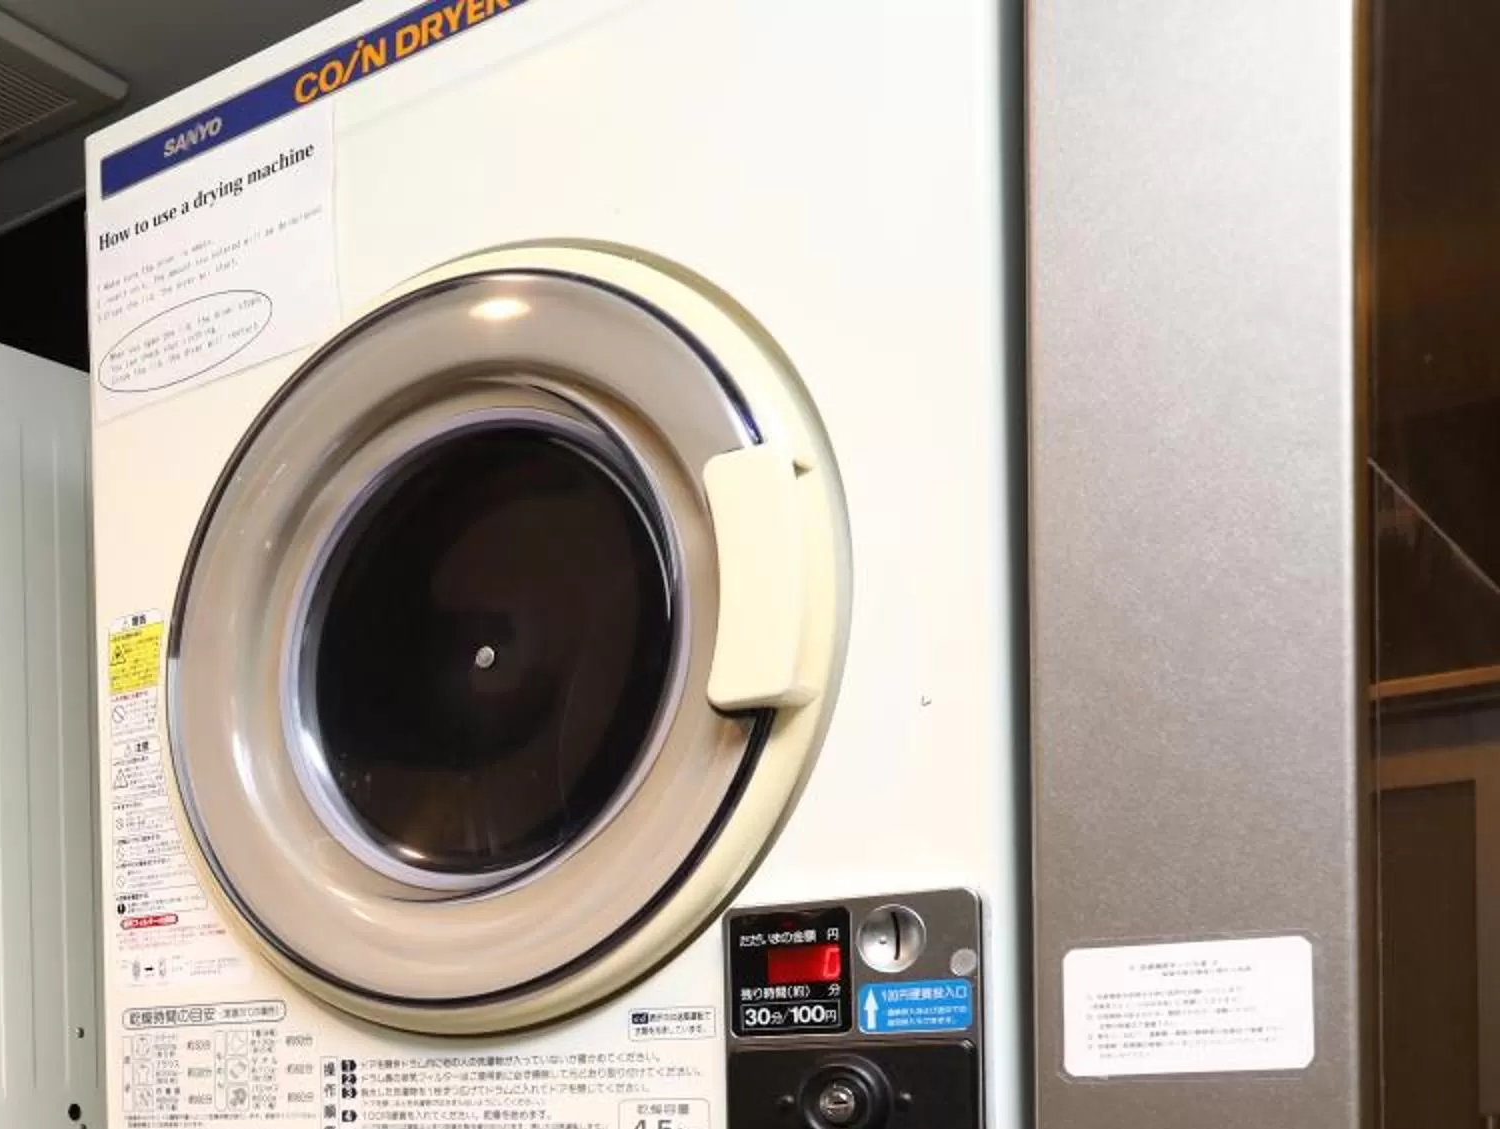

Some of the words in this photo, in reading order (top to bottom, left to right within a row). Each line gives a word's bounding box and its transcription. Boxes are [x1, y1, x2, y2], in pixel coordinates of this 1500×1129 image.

[163, 117, 222, 158] SANYO
[99, 228, 130, 251] How
[135, 219, 149, 235] to
[153, 208, 177, 228] use
[181, 201, 190, 215] a
[193, 178, 244, 208] drying
[248, 144, 315, 184] machine
[827, 928, 839, 940] 円
[823, 947, 841, 978] 0
[828, 983, 841, 997] 分
